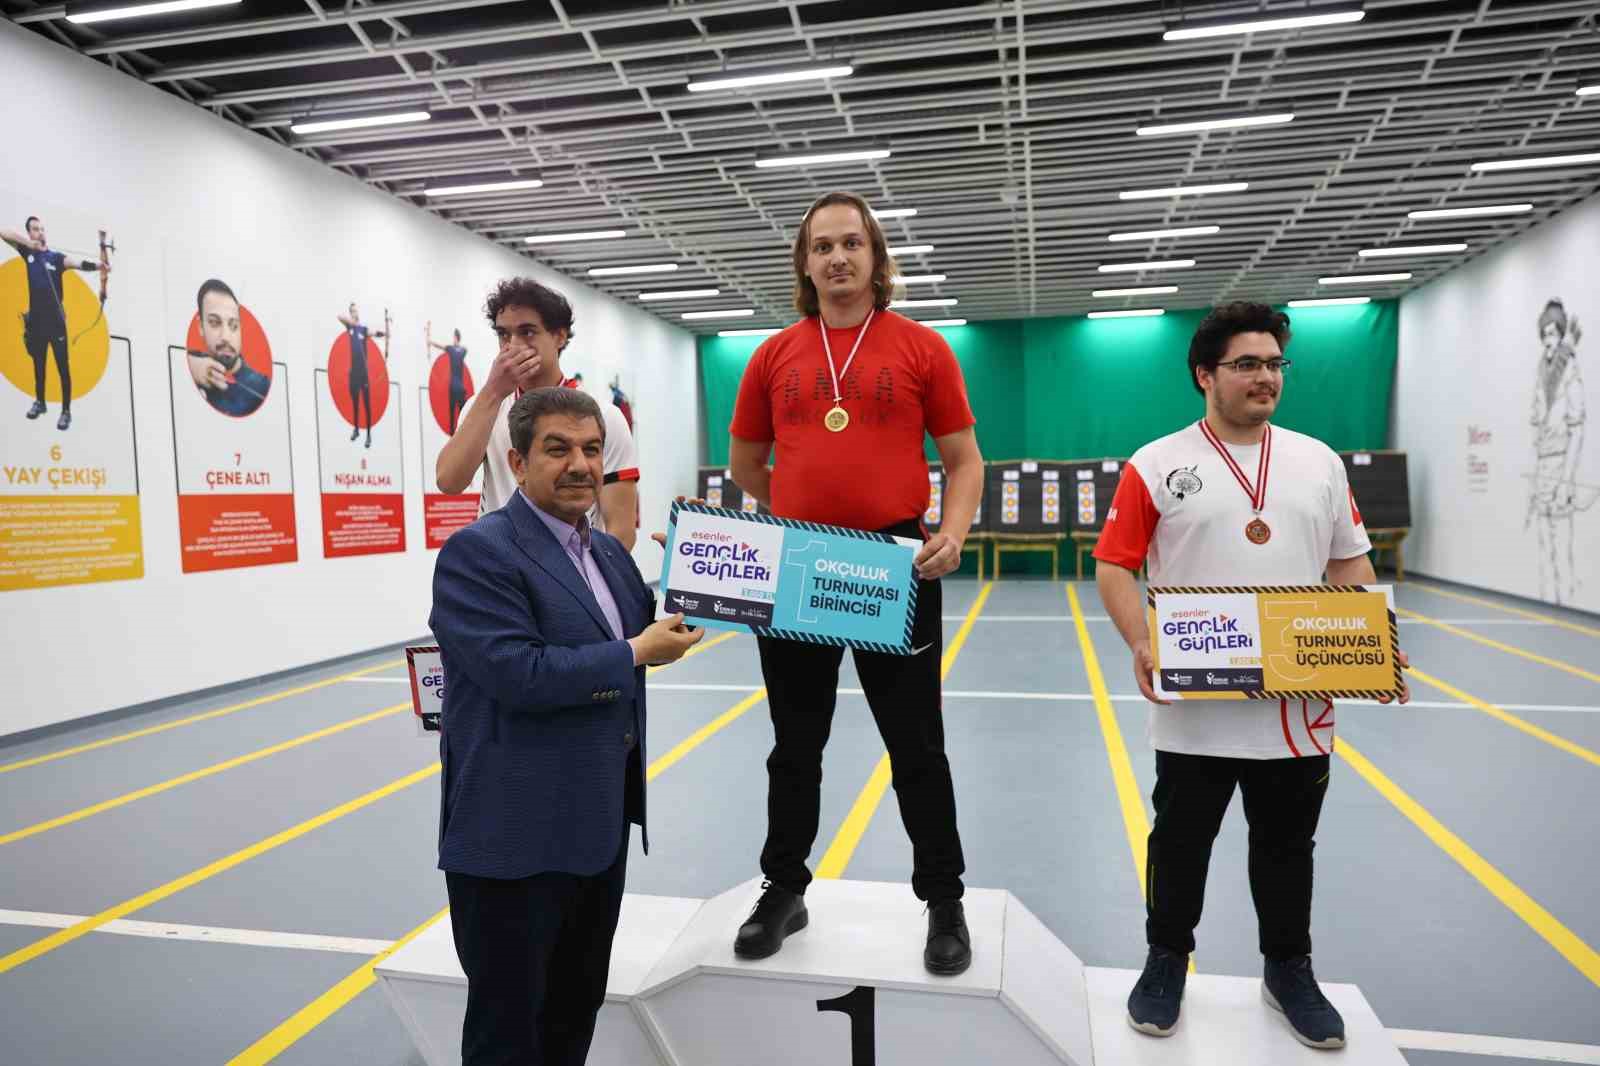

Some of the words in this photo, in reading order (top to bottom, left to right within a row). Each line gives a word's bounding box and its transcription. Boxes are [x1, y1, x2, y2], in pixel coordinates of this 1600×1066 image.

[50, 444, 62, 462] 6
[234, 453, 241, 466] 7
[3, 467, 42, 486] YAY
[48, 466, 107, 490] ÇEKİŞİ
[206, 471, 242, 490] ÇENE
[245, 471, 270, 485] ALTI
[335, 472, 365, 488] NİŞAN
[366, 474, 392, 486] ALMA
[691, 530, 732, 542] esenler
[815, 558, 891, 582] OKÇULUK
[812, 576, 900, 602] TURNUVASI
[810, 595, 881, 618] BİRİNCİSİ
[1171, 608, 1209, 619] esenler
[1292, 616, 1367, 632] OKÇULUK
[1294, 635, 1381, 648] TURNUVASI
[1296, 650, 1386, 668] ÜÇÜNCÜSÜ
[816, 985, 876, 1066] 1
